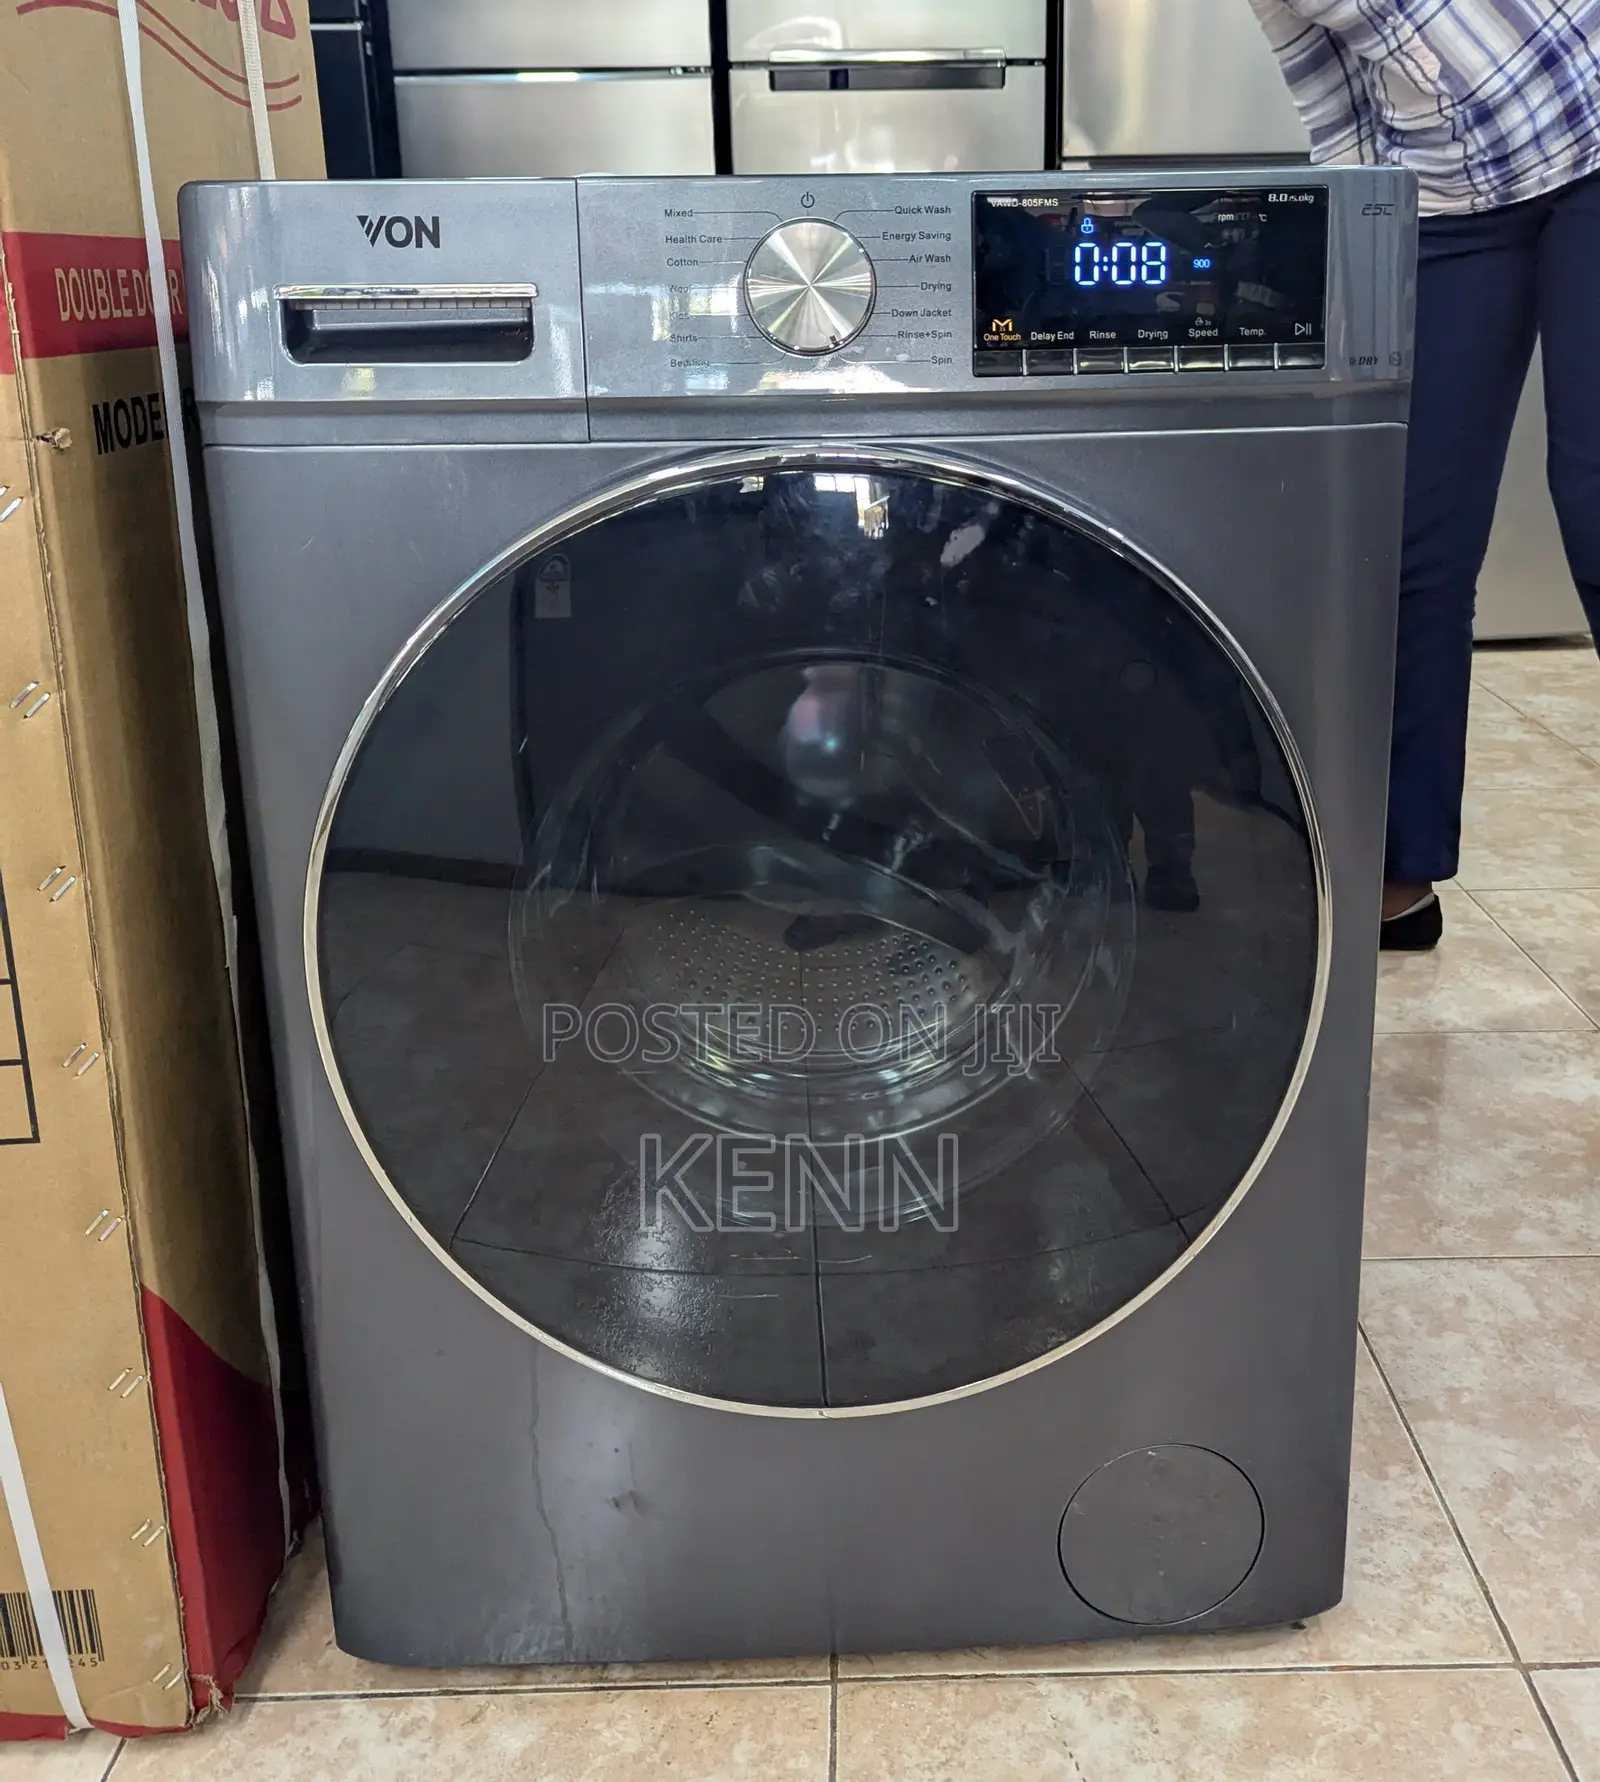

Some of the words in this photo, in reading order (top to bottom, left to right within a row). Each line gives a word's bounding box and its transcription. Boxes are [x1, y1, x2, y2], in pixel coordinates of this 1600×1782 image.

[990, 198, 1059, 208] VAWD-805FMS
[664, 208, 693, 218] Mixed
[894, 205, 922, 215] Quick
[924, 205, 951, 214] Wash
[1218, 213, 1234, 222] rpm
[356, 215, 441, 249] VON
[882, 231, 916, 242] Energy
[918, 230, 952, 242] Saving
[665, 235, 697, 244] Health
[699, 234, 723, 244] Care
[666, 257, 699, 267] Cotton
[909, 254, 923, 263] Air
[924, 254, 952, 263] Wash
[1193, 258, 1211, 269] 900
[1074, 242, 1166, 286] 0:08
[920, 281, 952, 292] Drying
[54, 267, 133, 321] DOUBLE
[132, 268, 184, 317] DR
[891, 308, 918, 318] Down
[920, 308, 952, 317] Jacket
[897, 330, 953, 340] Rinse+Spin
[983, 333, 999, 341] One
[1000, 332, 1022, 341] Touch
[1030, 331, 1056, 342] Delay
[1057, 331, 1075, 340] End
[1089, 330, 1117, 339] Rinse
[1137, 329, 1169, 340] Drying
[1188, 328, 1219, 338] Speed
[1239, 327, 1267, 337] Temp.
[669, 333, 698, 343] Shirts
[931, 355, 953, 366] Spin
